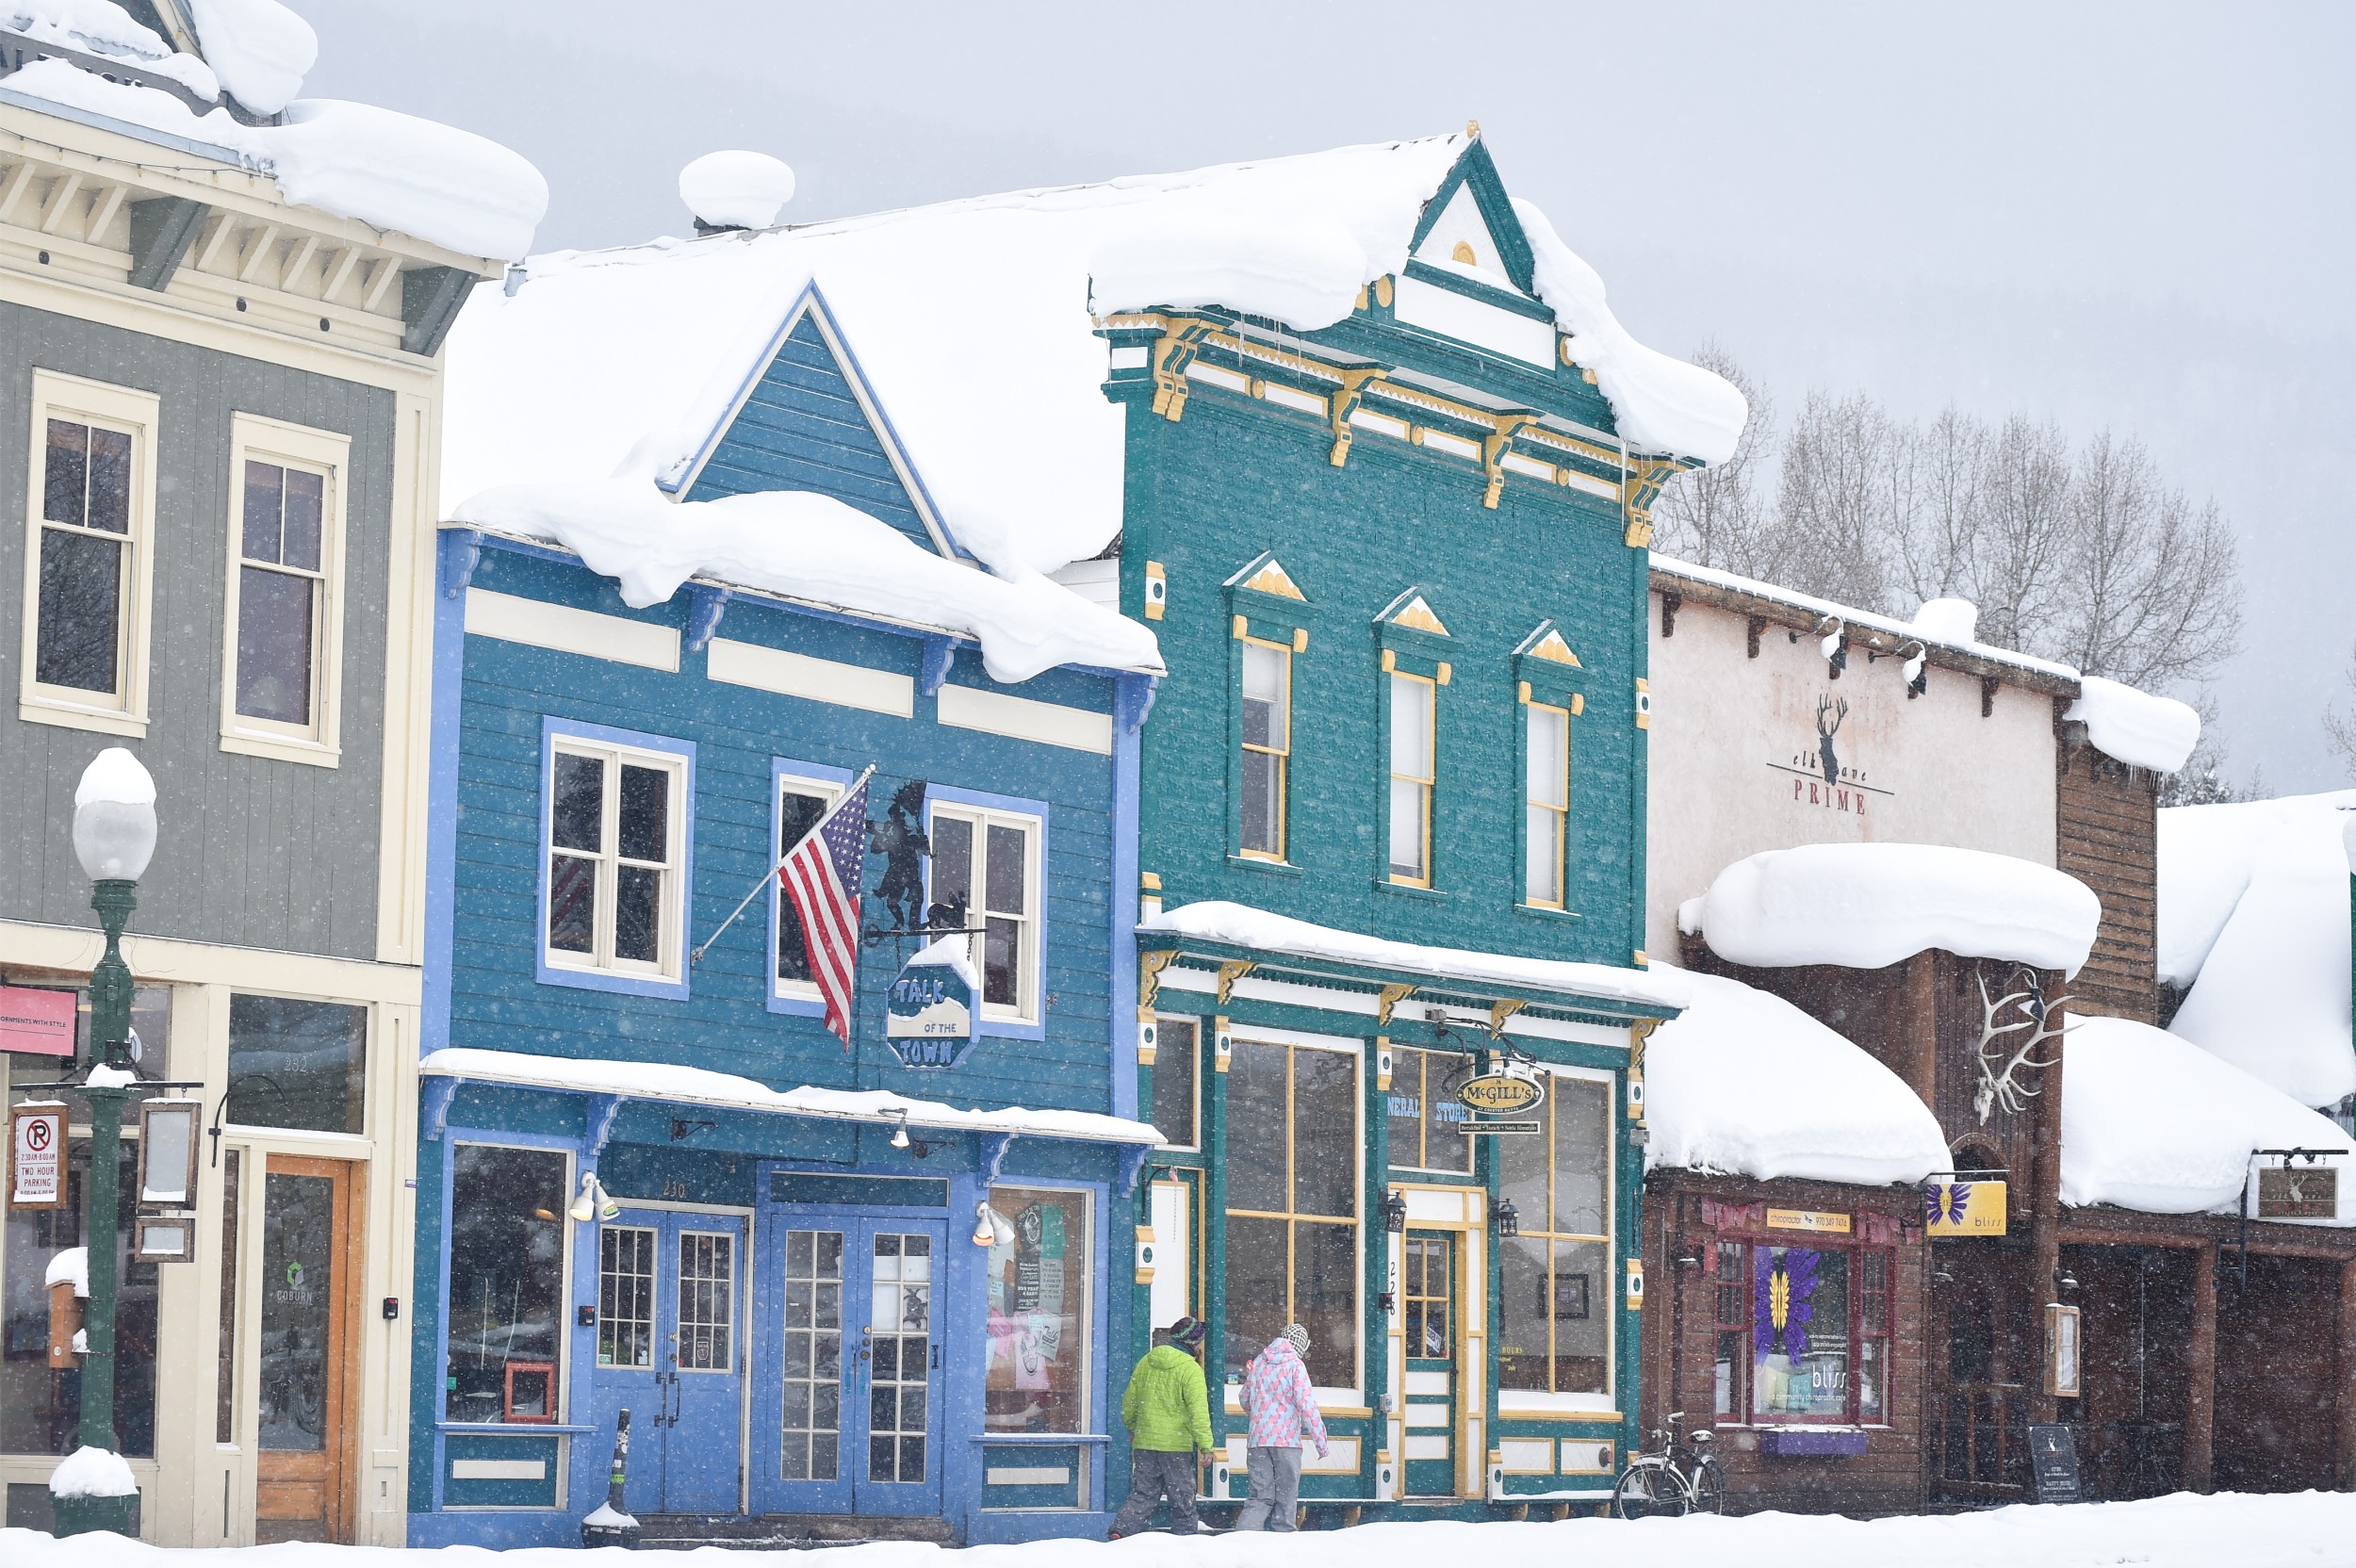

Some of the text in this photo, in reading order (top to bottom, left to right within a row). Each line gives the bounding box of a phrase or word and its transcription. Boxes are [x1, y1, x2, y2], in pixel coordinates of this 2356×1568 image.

[1793, 751, 1866, 781] elk ave
[1794, 778, 1865, 815] PRIME
[895, 979, 945, 1004] TALK
[924, 1023, 957, 1033] OF THE
[899, 1040, 953, 1064] TOWN
[284, 1056, 307, 1072] 232
[1435, 1102, 1468, 1122] STORE
[22, 1167, 55, 1176] TWO HOUR
[24, 1178, 51, 1187] PARKING
[663, 1180, 685, 1199] 230
[1771, 1214, 1802, 1225] chiropractor
[1815, 1217, 1825, 1226] 970
[1974, 1217, 2002, 1227] bliss
[276, 1290, 312, 1302] COBURN
[1812, 1364, 1847, 1389] bliss
[1776, 1394, 1805, 1403] community
[1805, 1394, 1835, 1402] chiropractic
